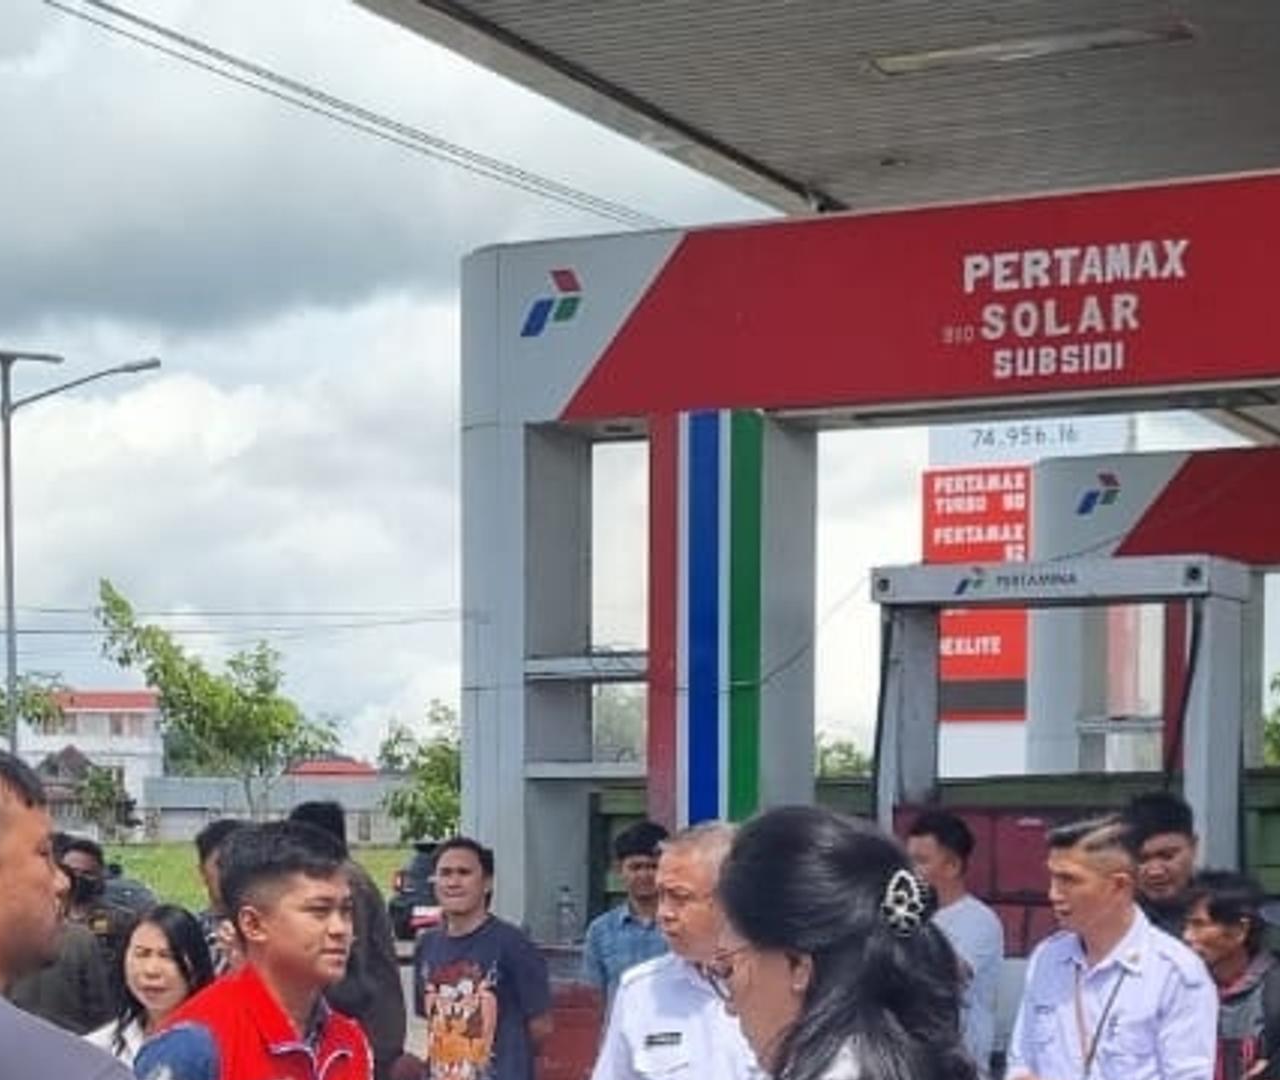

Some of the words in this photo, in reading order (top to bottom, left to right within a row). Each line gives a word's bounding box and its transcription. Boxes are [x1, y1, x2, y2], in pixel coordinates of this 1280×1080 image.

[962, 239, 1189, 294] PERTAMAX
[981, 293, 1140, 341] SOLAR
[993, 342, 1124, 379] SUBSIDI
[933, 472, 1026, 495] PERTAMAX
[933, 523, 1026, 546] PERTAMAX
